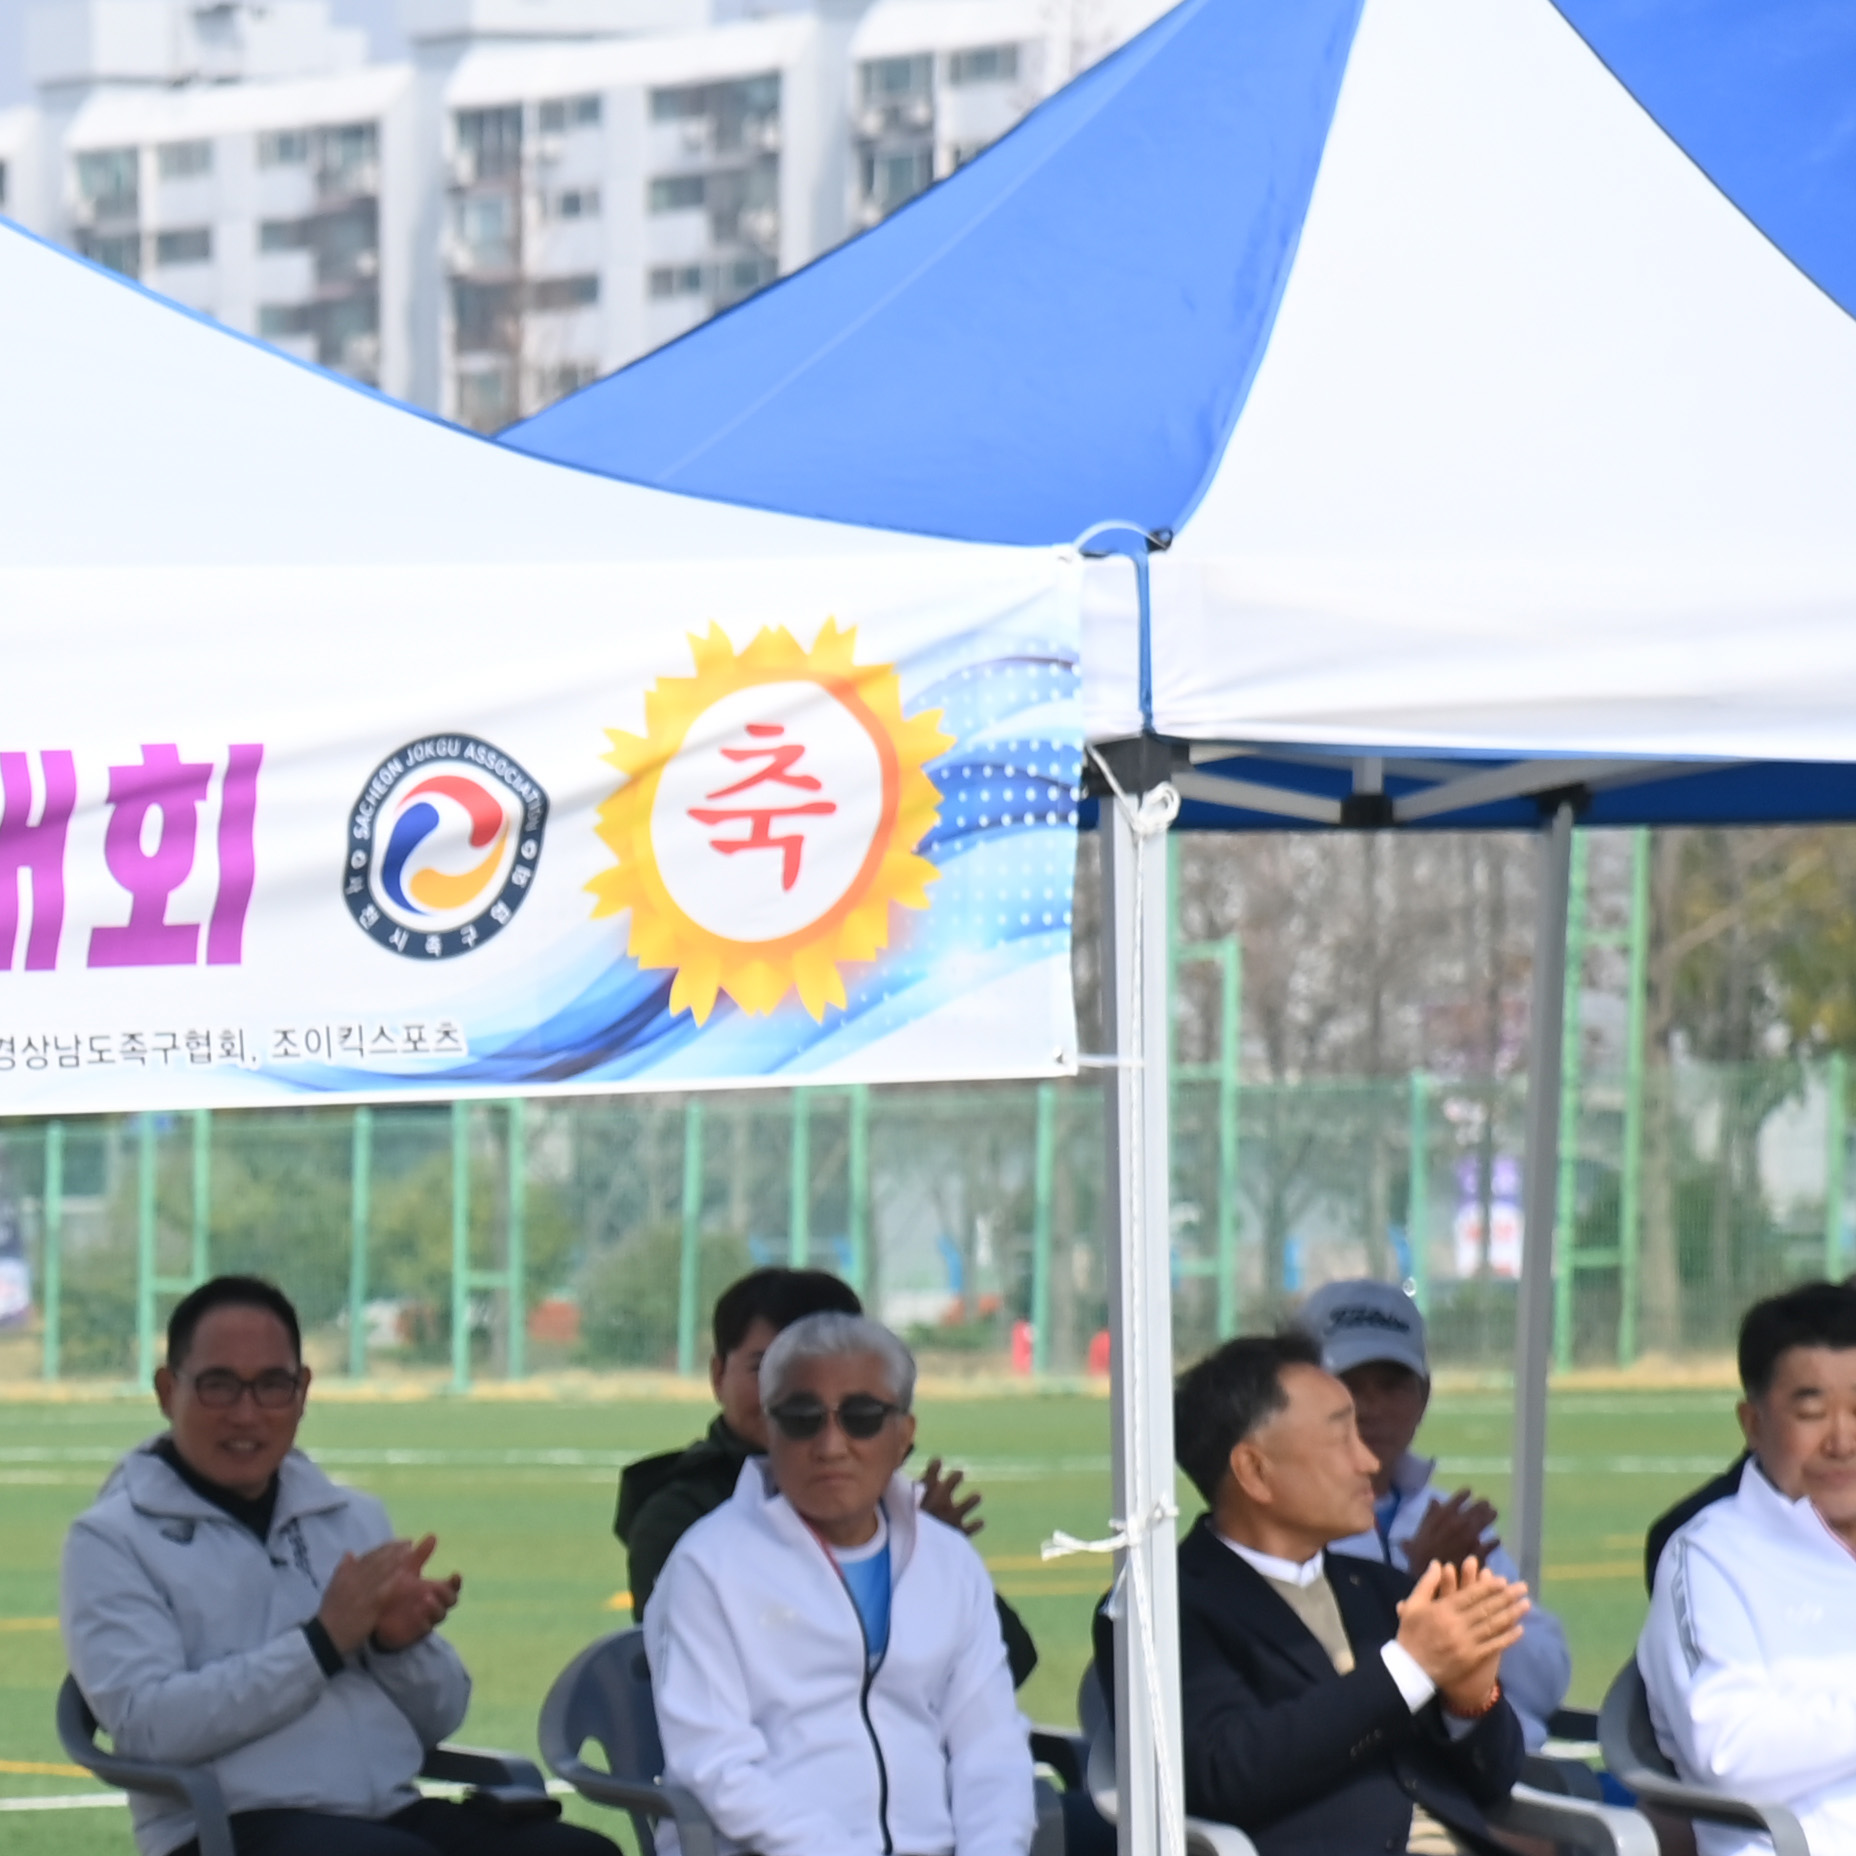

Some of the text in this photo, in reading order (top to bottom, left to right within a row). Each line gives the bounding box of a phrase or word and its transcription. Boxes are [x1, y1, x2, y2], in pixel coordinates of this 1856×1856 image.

[353, 757, 404, 840] SACHEON
[406, 738, 461, 767] JOKGU
[688, 722, 838, 893] 축
[272, 1022, 463, 1058] 조이킥스포츠
